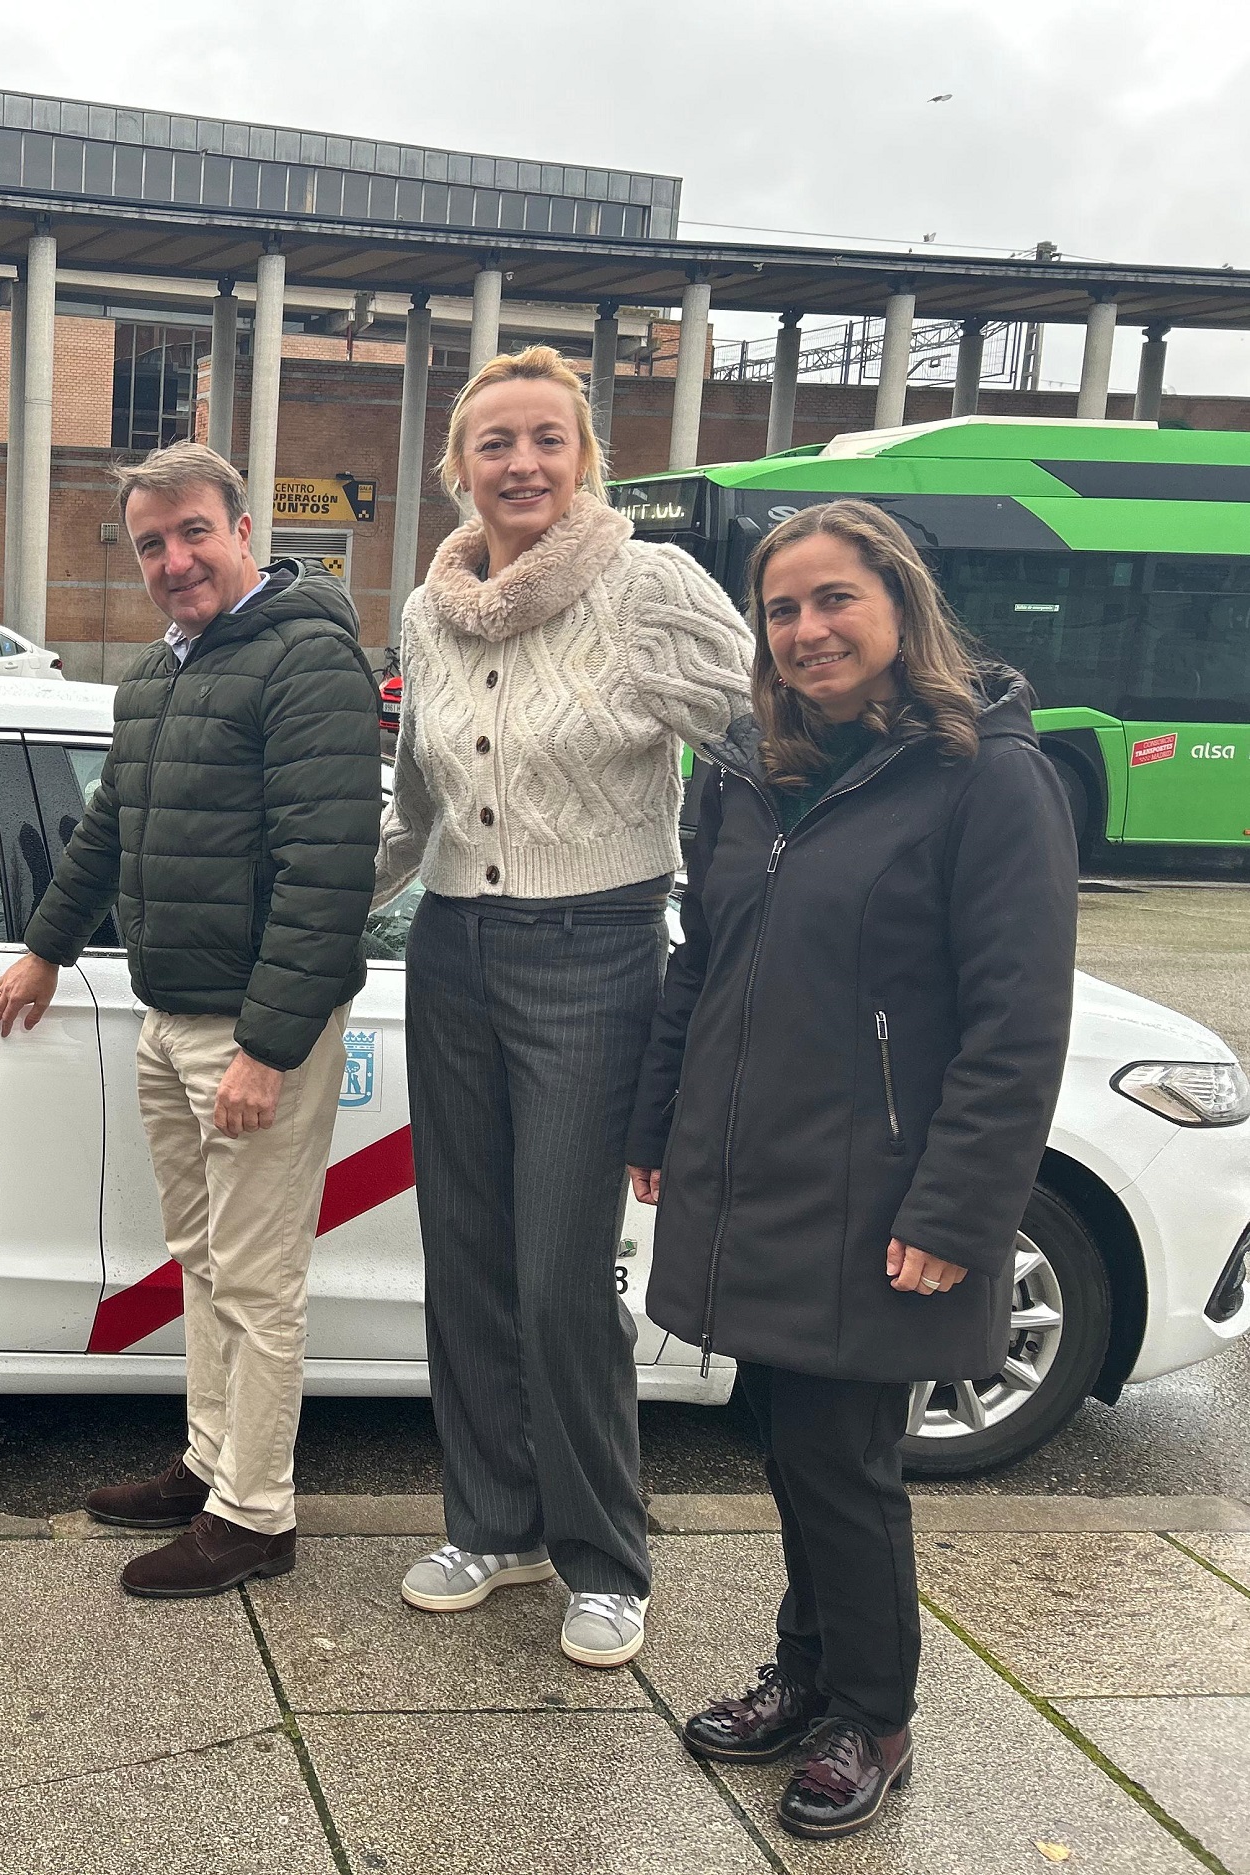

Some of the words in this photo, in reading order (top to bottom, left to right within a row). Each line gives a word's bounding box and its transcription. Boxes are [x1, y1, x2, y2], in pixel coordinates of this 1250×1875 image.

[275, 483, 314, 493] CENTRO
[273, 493, 338, 503] UPERACIÓN
[1151, 750, 1172, 760] MADRID
[1191, 742, 1235, 759] alsa
